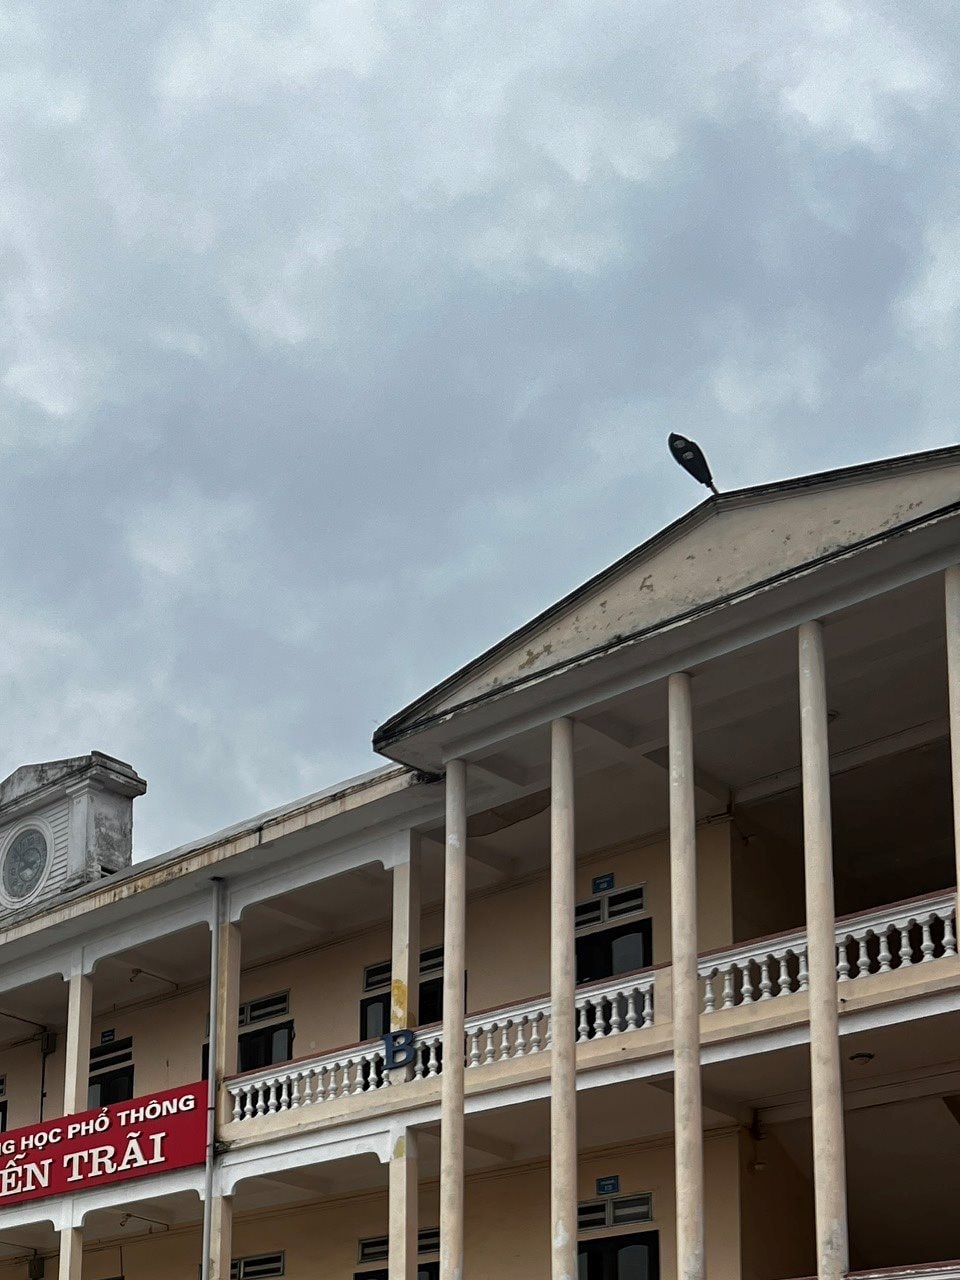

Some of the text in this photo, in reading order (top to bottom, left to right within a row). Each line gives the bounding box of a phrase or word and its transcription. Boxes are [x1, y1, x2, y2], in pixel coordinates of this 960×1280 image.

[381, 1029, 417, 1070] B
[20, 1127, 62, 1150] HỌC
[67, 1107, 110, 1140] PHỔ
[116, 1094, 196, 1126] THÔNG
[63, 1130, 167, 1182] TRÃI
